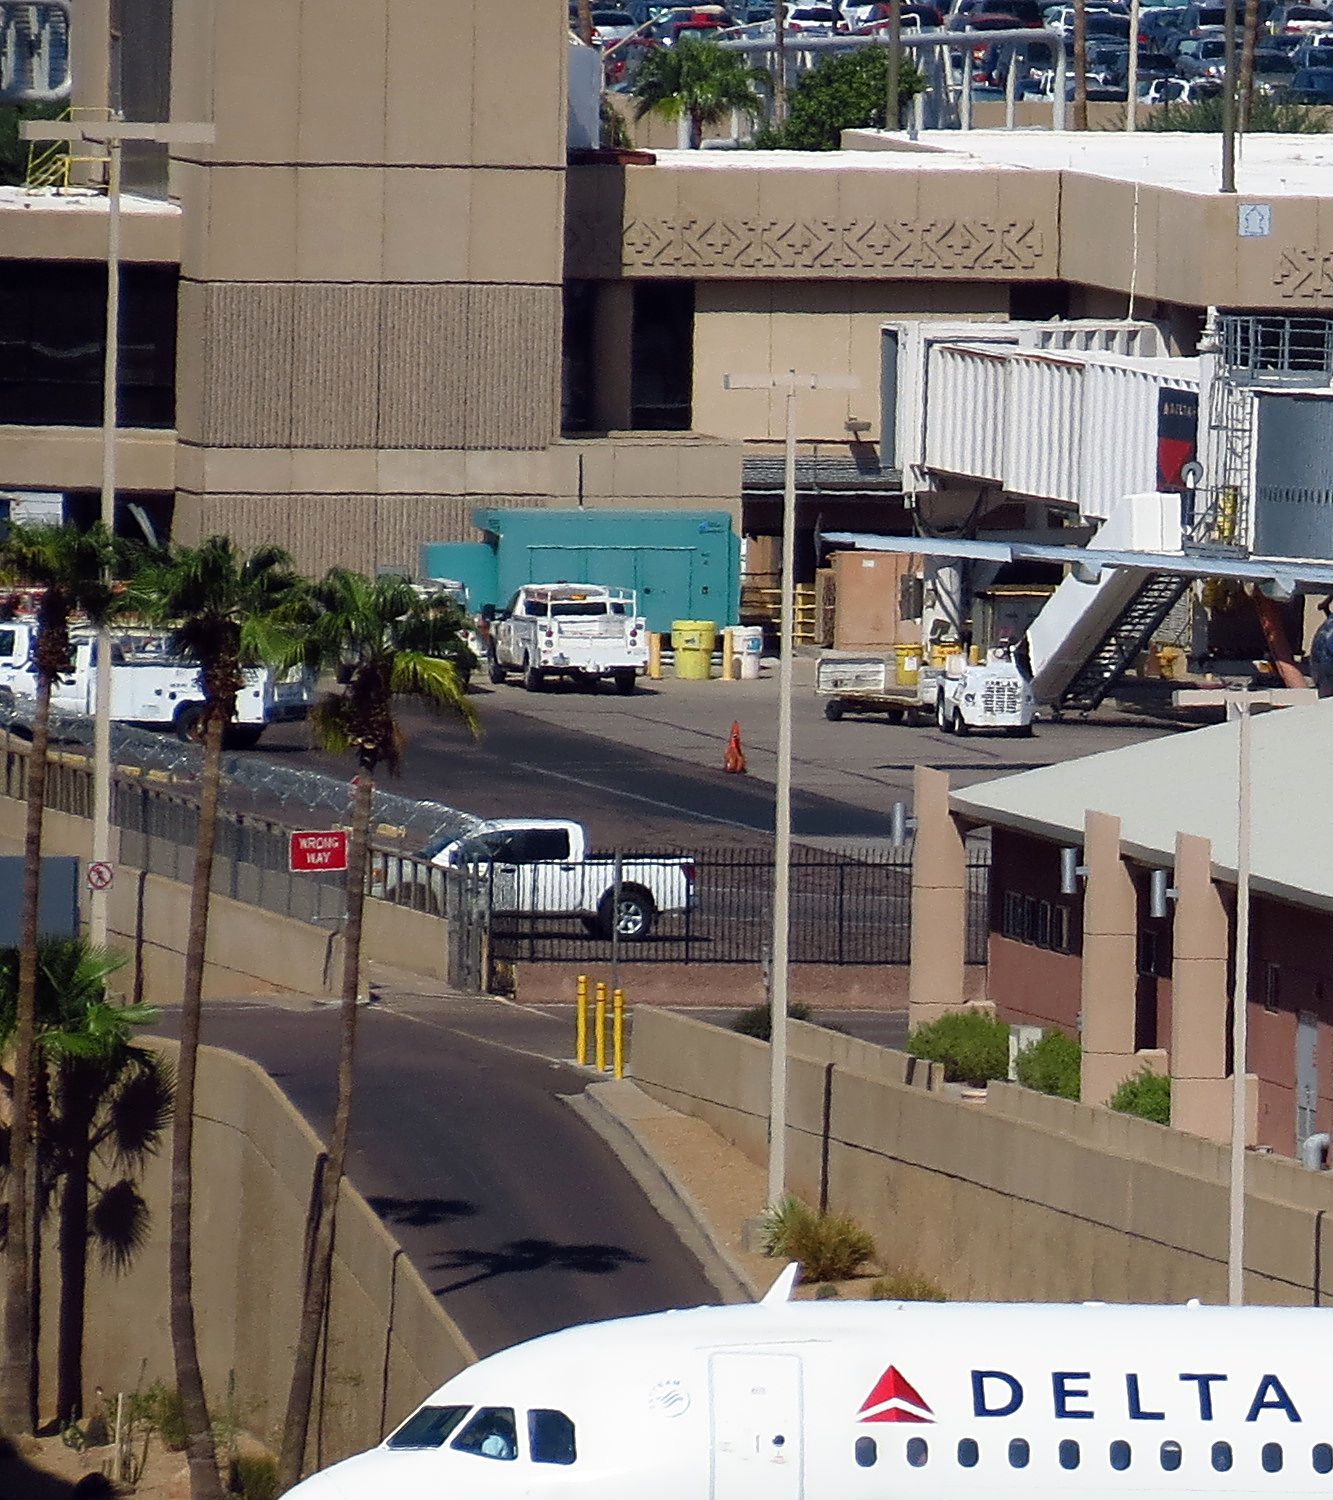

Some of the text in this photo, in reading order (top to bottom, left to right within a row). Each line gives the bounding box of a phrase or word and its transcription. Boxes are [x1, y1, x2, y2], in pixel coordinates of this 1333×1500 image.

[298, 837, 340, 850] WRONG
[306, 852, 332, 864] WAY
[970, 1369, 1302, 1423] DELTA
